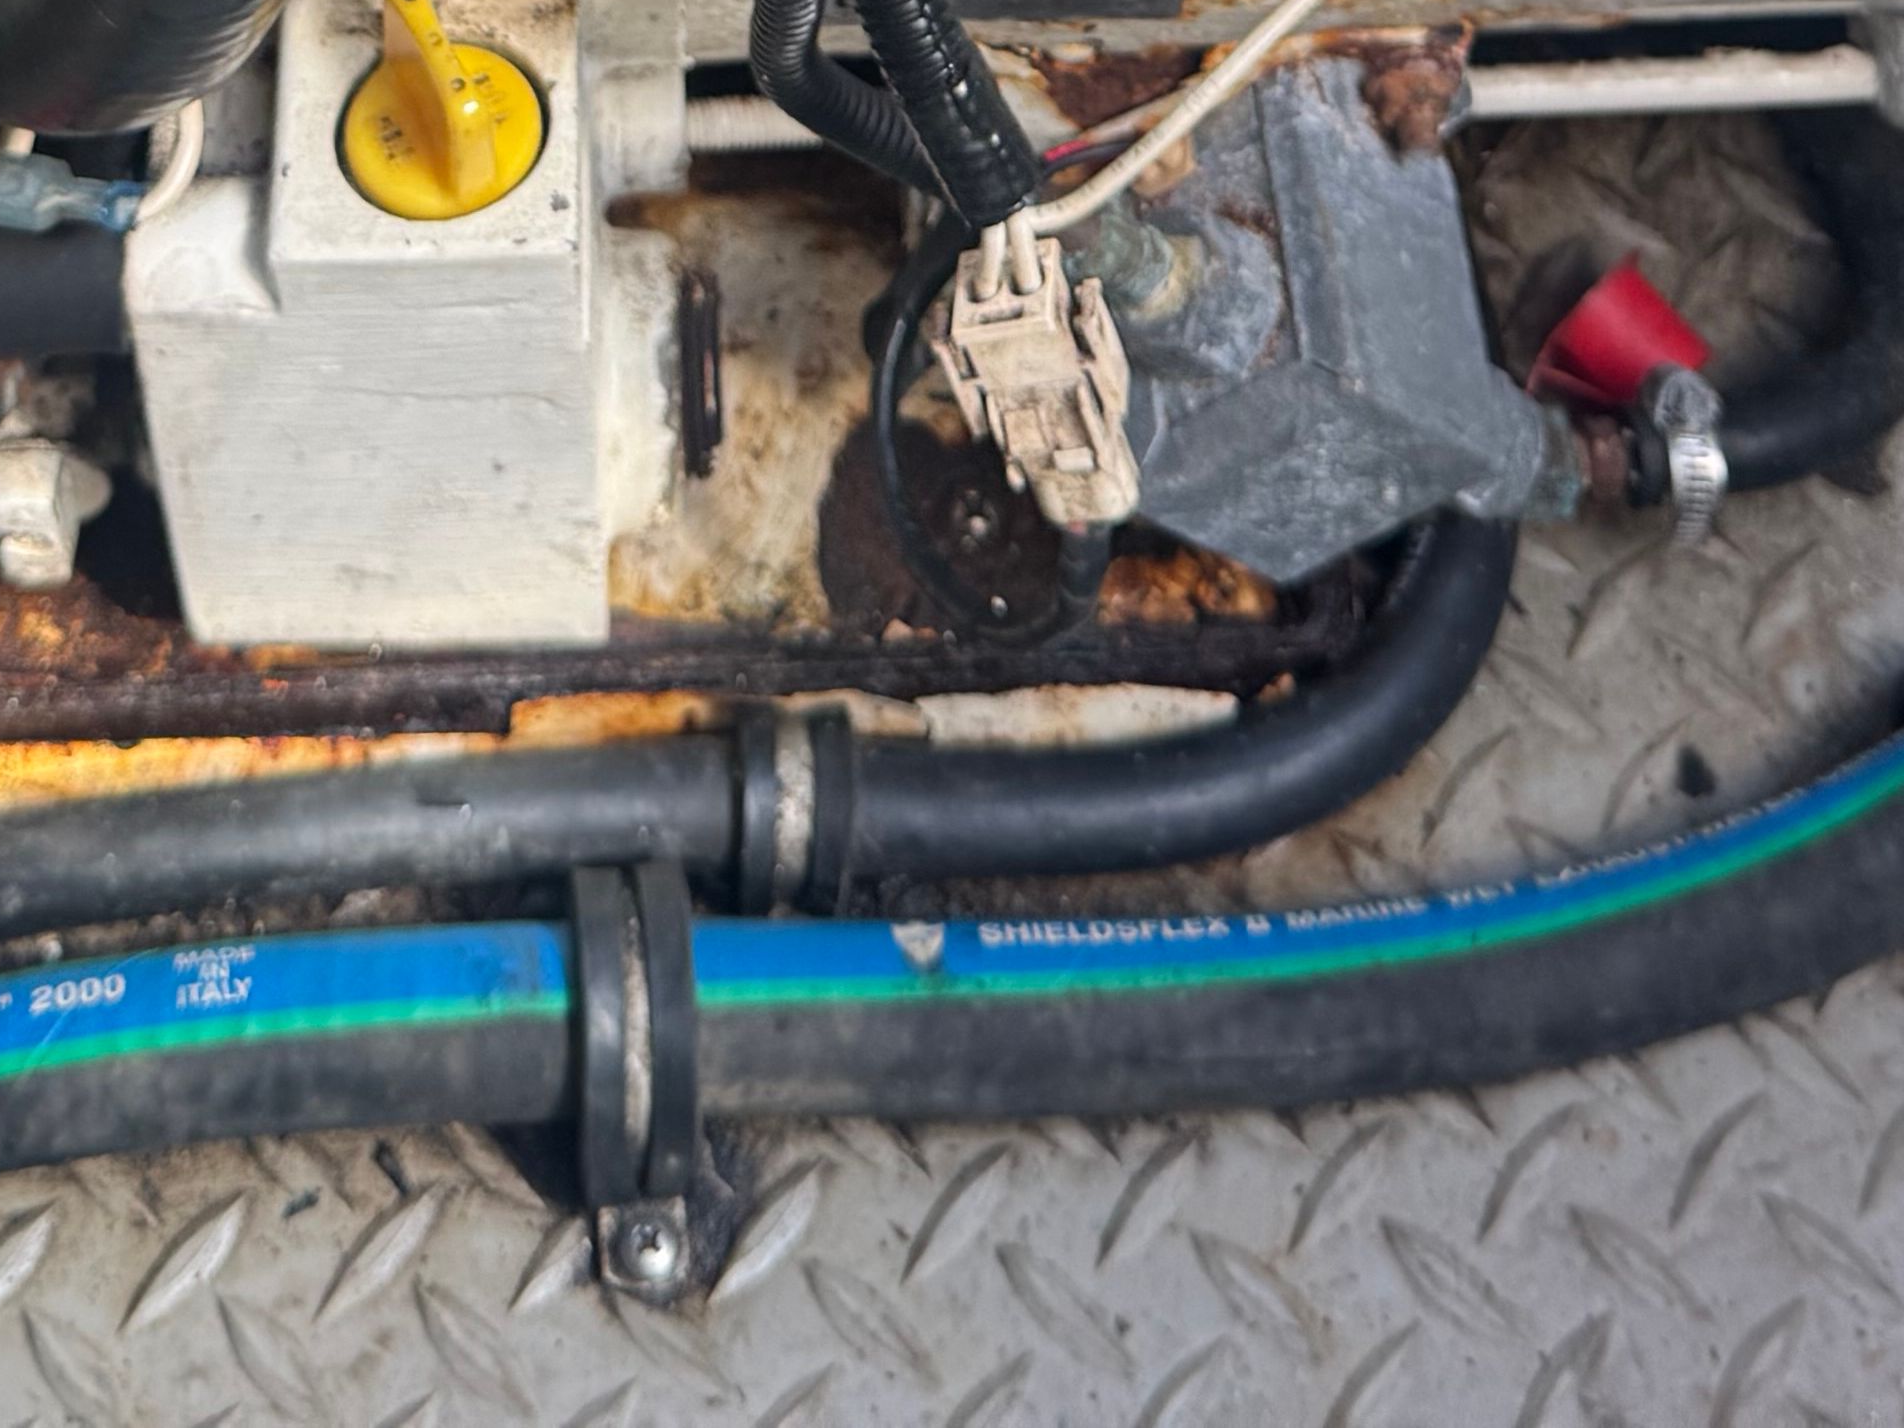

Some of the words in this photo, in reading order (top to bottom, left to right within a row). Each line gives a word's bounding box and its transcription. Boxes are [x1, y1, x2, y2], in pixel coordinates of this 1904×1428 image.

[978, 915, 1229, 947] SHIELDSFLEX
[28, 973, 126, 1017] 2000
[175, 975, 253, 1010] ITALY
